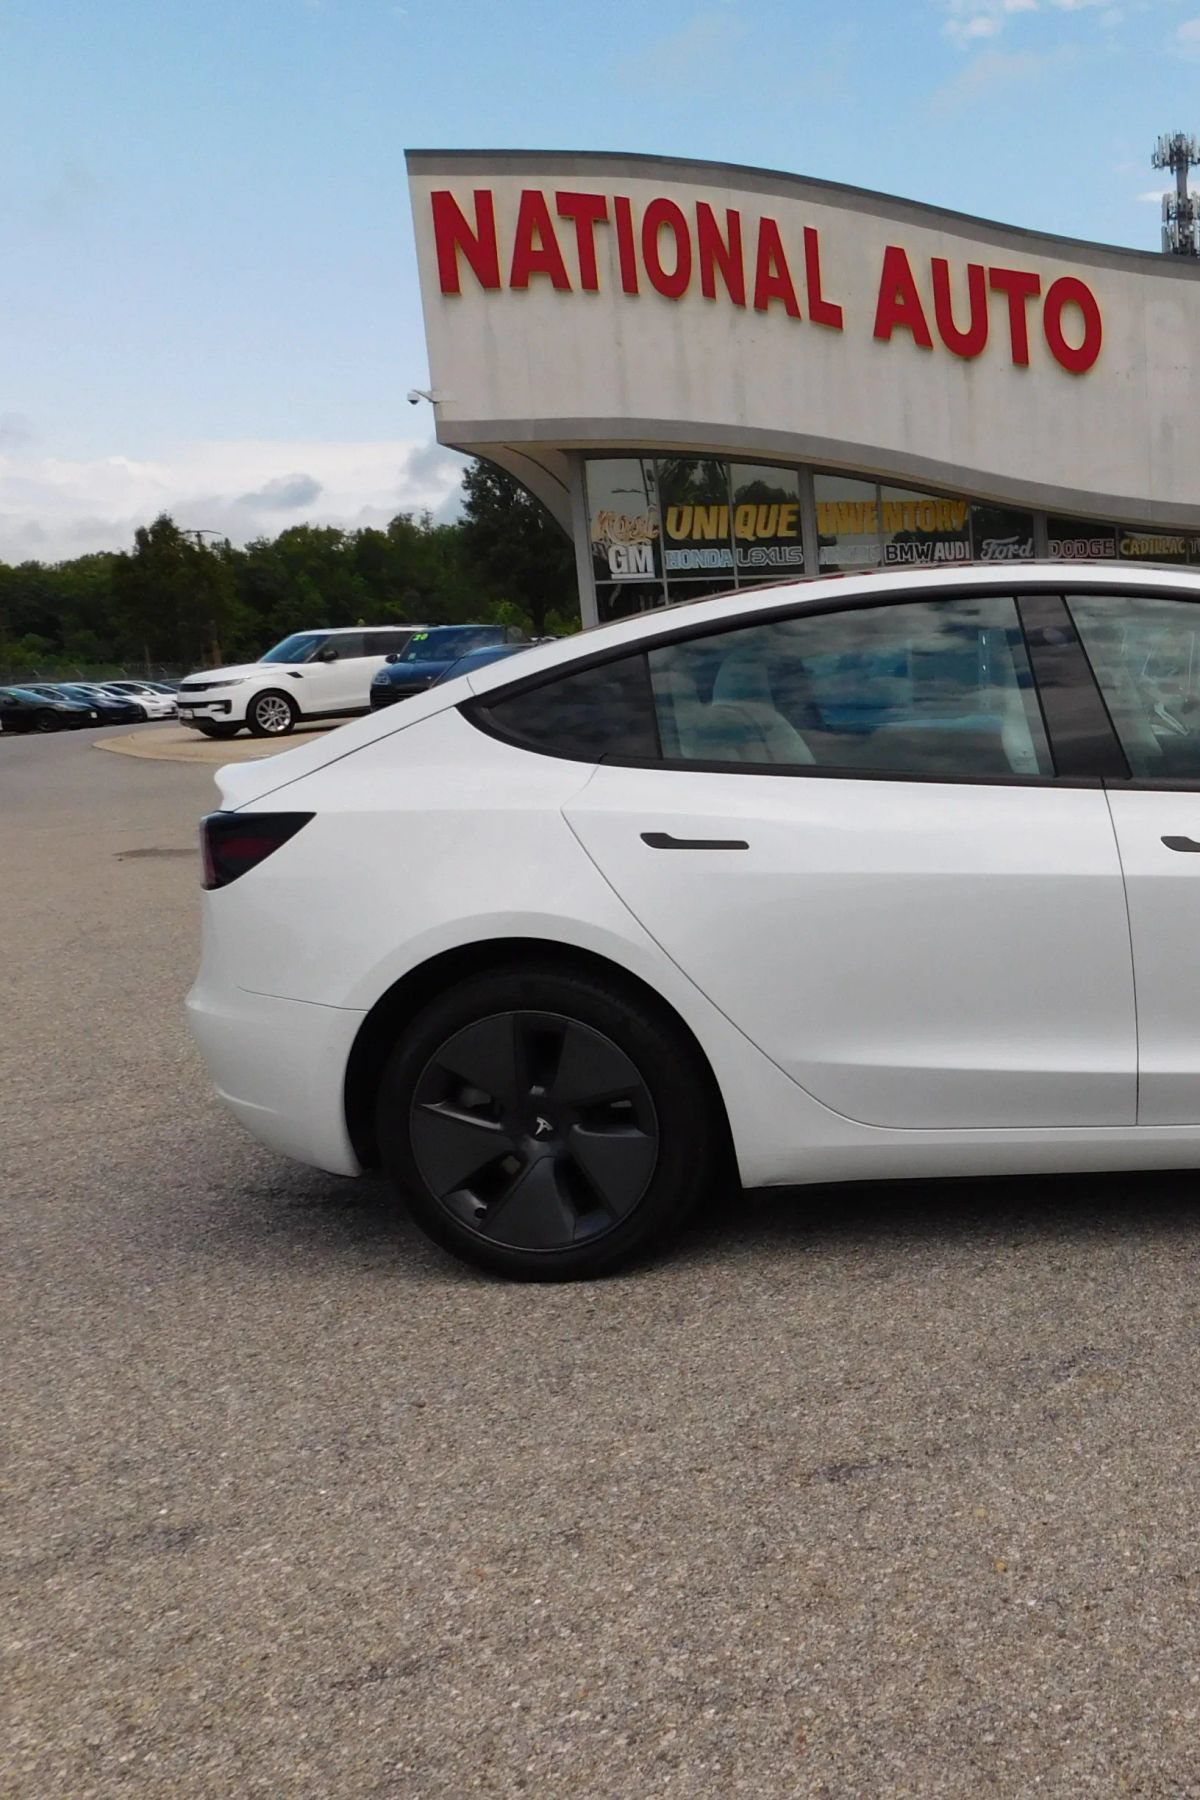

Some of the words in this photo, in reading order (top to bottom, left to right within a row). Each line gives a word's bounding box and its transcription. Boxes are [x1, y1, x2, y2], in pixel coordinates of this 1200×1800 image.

[430, 189, 844, 331] NATIONAL
[873, 245, 1103, 374] AUTO
[666, 503, 800, 541] UNIQUE
[607, 544, 656, 574] GM
[665, 548, 733, 570] HONDA
[736, 545, 804, 567] LEXUS
[883, 541, 934, 564] BMW
[934, 541, 970, 561] AUDI
[979, 535, 1034, 561] Ford
[1047, 538, 1116, 559] DODGE
[1119, 537, 1186, 556] CADILLAC
